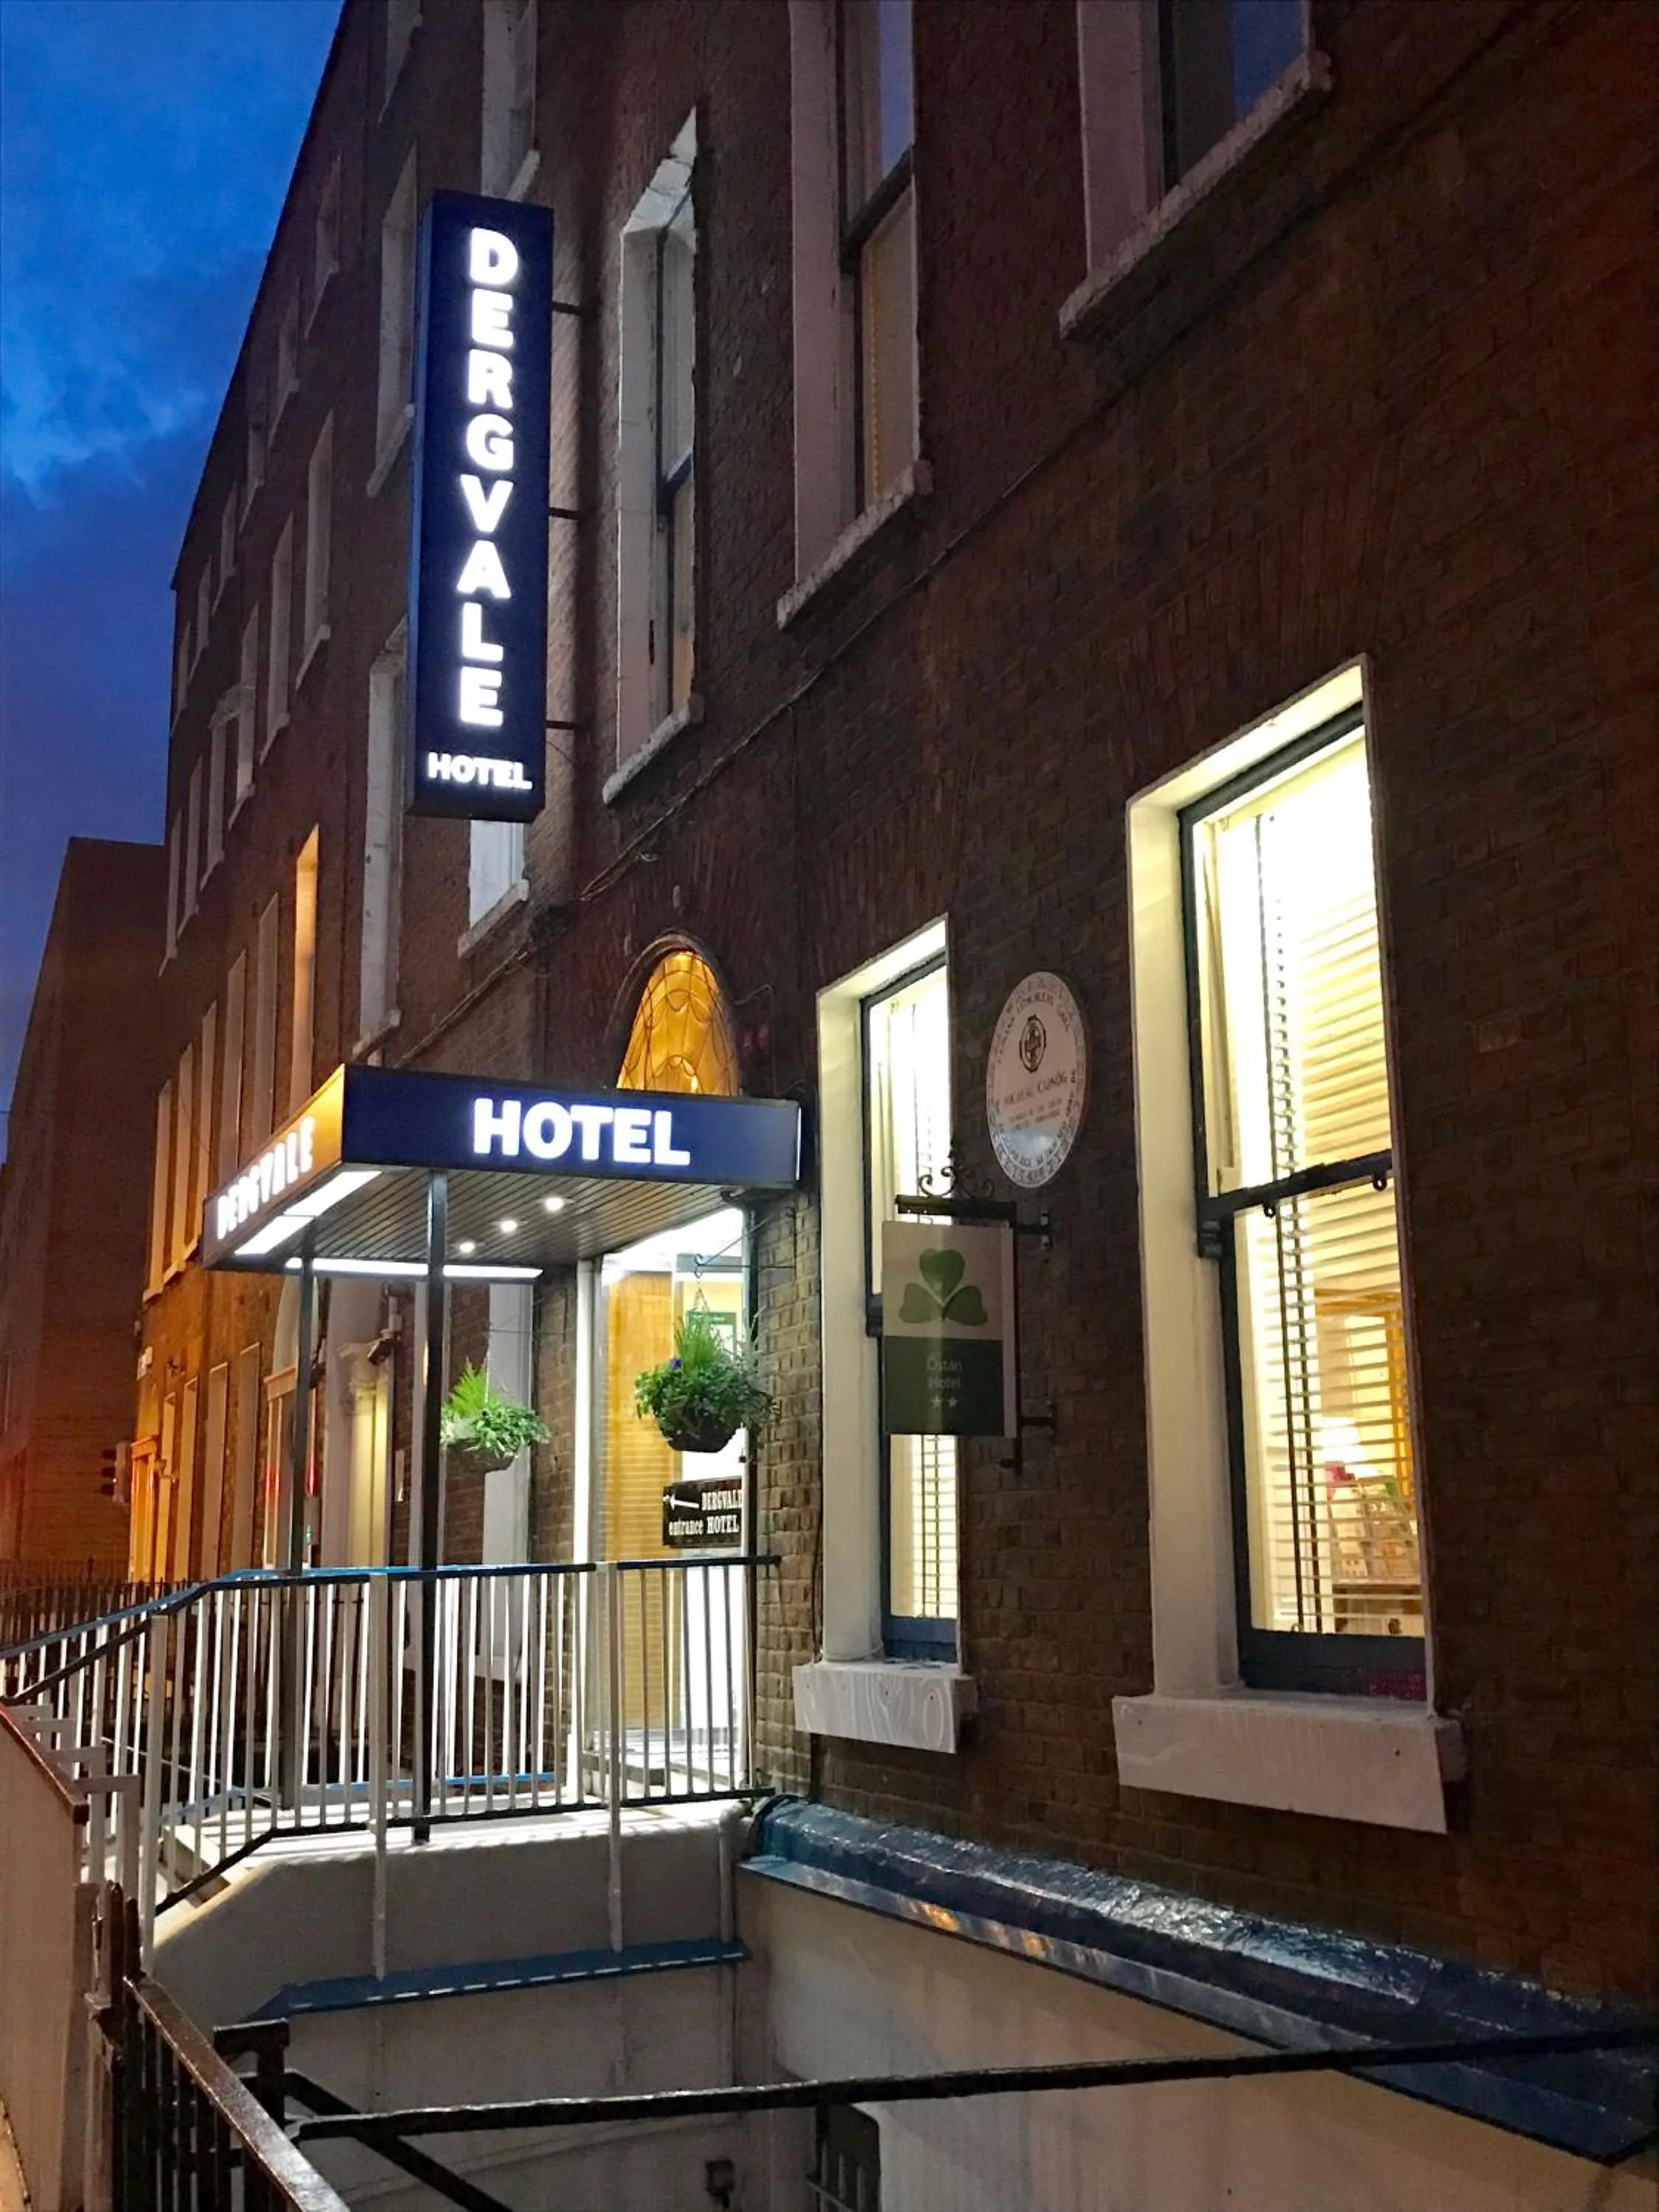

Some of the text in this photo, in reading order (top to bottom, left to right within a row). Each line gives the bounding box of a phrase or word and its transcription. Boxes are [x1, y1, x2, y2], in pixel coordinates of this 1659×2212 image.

[455, 226, 521, 729] DERGVALE
[428, 751, 533, 790] HOTEL
[471, 1096, 692, 1166] HOTEL
[701, 1489, 742, 1511] DERGVALE
[669, 1514, 740, 1536] entrance HOTEL
